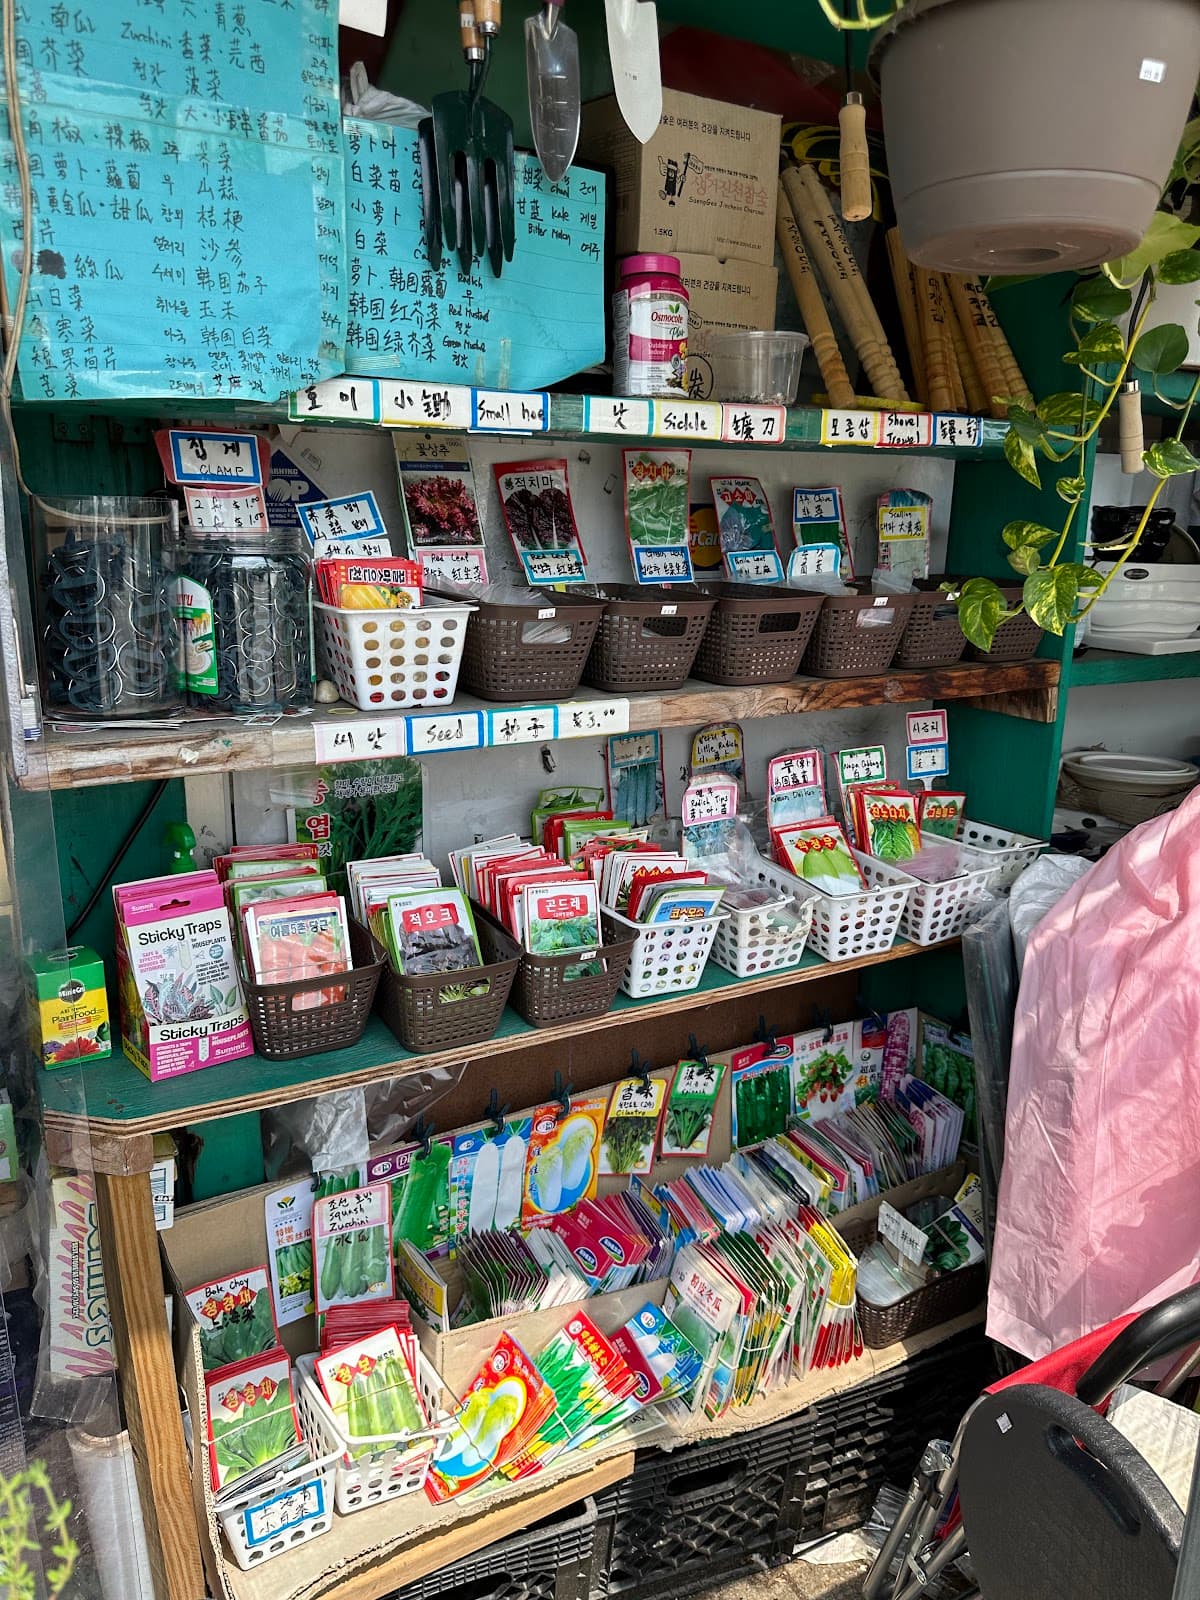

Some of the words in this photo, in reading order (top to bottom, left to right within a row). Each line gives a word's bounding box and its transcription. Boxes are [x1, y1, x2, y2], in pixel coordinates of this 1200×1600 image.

[651, 311, 683, 324] Osmocote
[478, 399, 511, 426] Small
[521, 401, 545, 421] hoe
[663, 407, 708, 431] Sickle
[831, 411, 870, 439] 모종삽
[887, 413, 919, 428] Shovel
[416, 442, 450, 458] 꽃상추
[200, 464, 244, 476] CLAMP
[514, 474, 554, 490] 적치마
[195, 500, 204, 509] 2
[197, 517, 204, 528] 3
[426, 718, 464, 744] Seed
[912, 720, 939, 735] 시금치
[131, 903, 154, 912] Summit
[545, 896, 582, 912] 곤드레
[668, 906, 706, 920] 코스모스
[138, 925, 186, 947] Sticky
[185, 918, 223, 937] Traps
[191, 936, 227, 950] HOUSEPLANTS
[73, 1007, 97, 1019] Food
[160, 1026, 209, 1042] Sticky
[209, 1013, 245, 1033] Traps
[211, 1029, 250, 1047] HOUSEPLANTS
[214, 1042, 248, 1056] Summit
[329, 1205, 365, 1222] squash
[229, 1278, 250, 1290] Choy
[690, 1273, 723, 1313] 粉皮冬瓜
